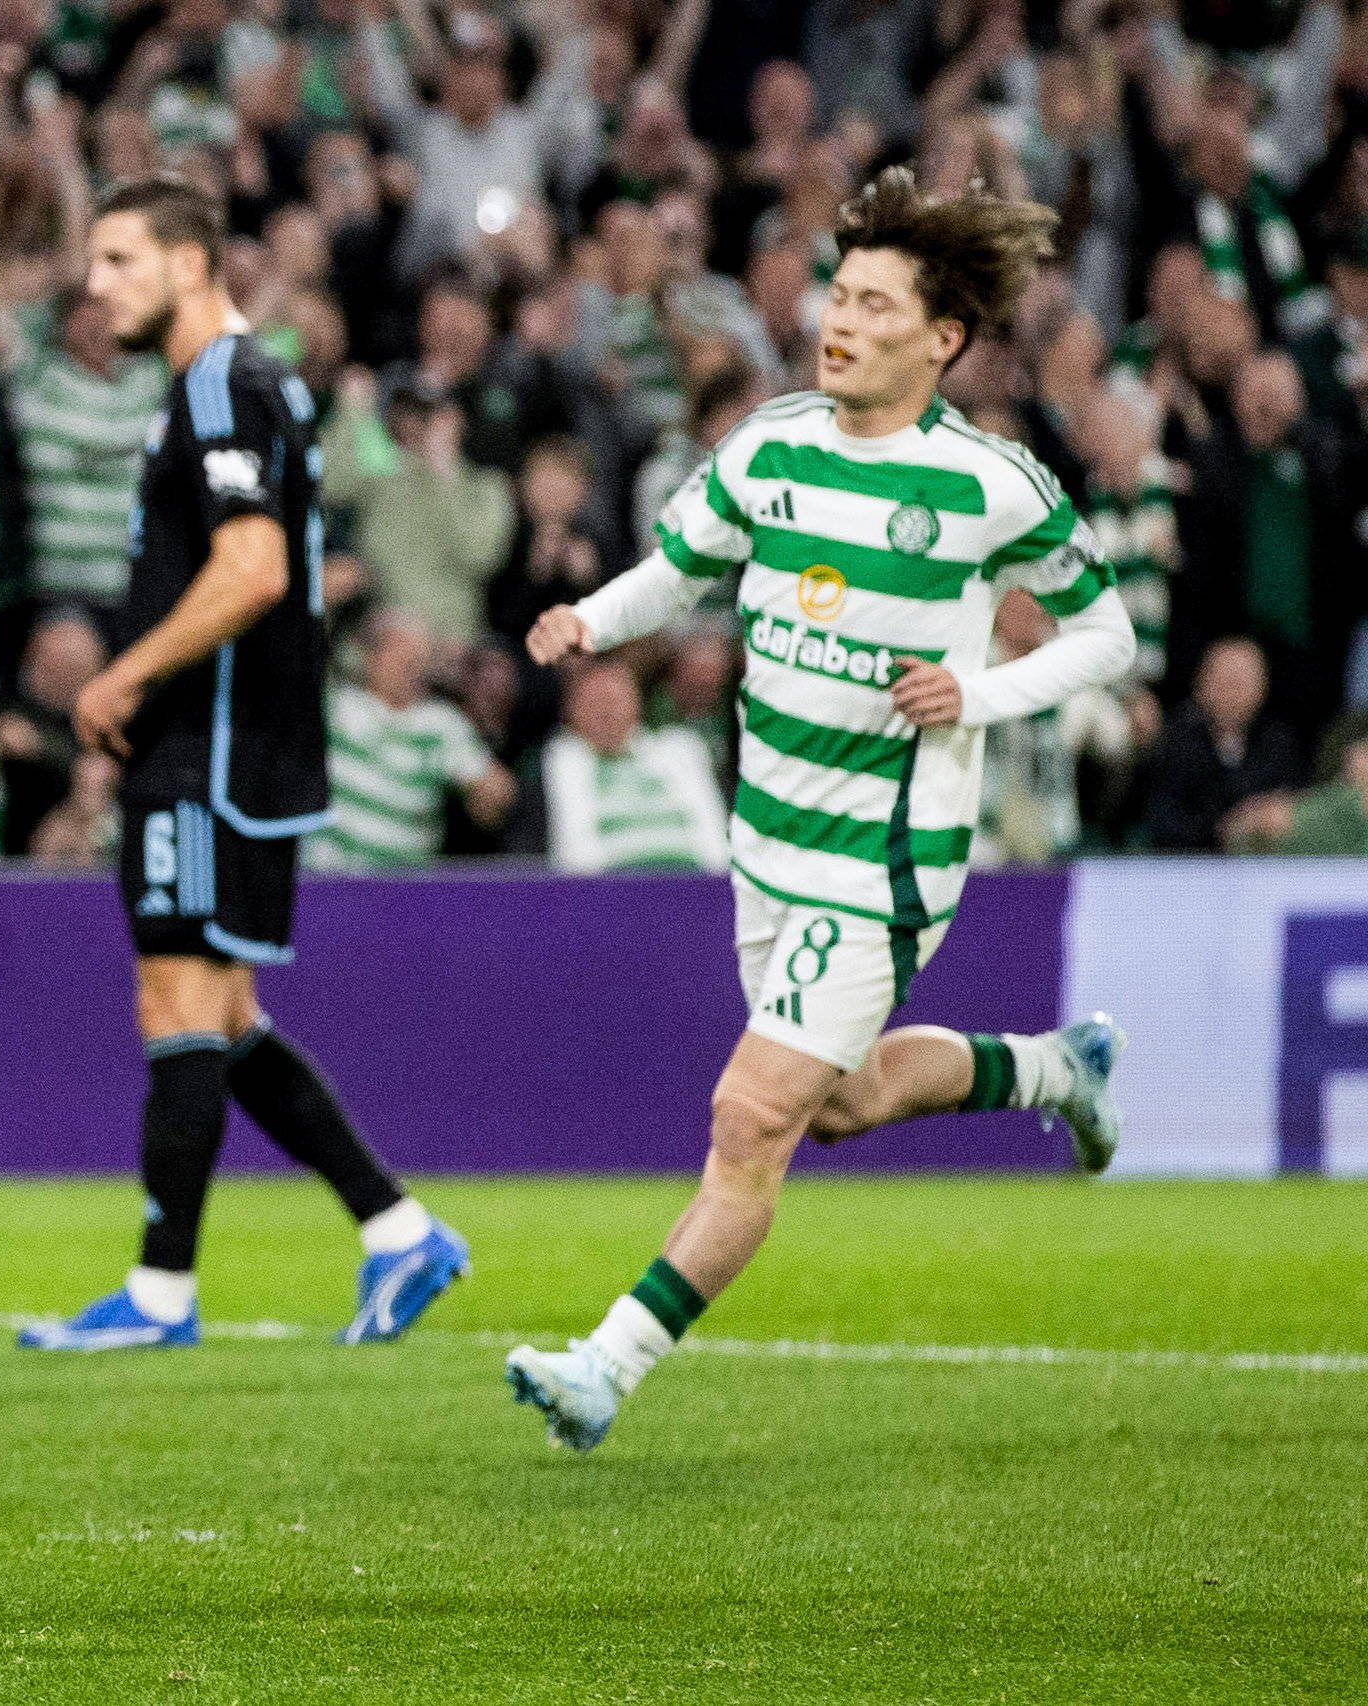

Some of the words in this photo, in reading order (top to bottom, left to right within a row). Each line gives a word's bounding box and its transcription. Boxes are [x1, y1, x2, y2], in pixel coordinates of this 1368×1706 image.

[752, 616, 892, 685] dafabet
[143, 810, 177, 884] 6
[786, 917, 841, 985] 8
